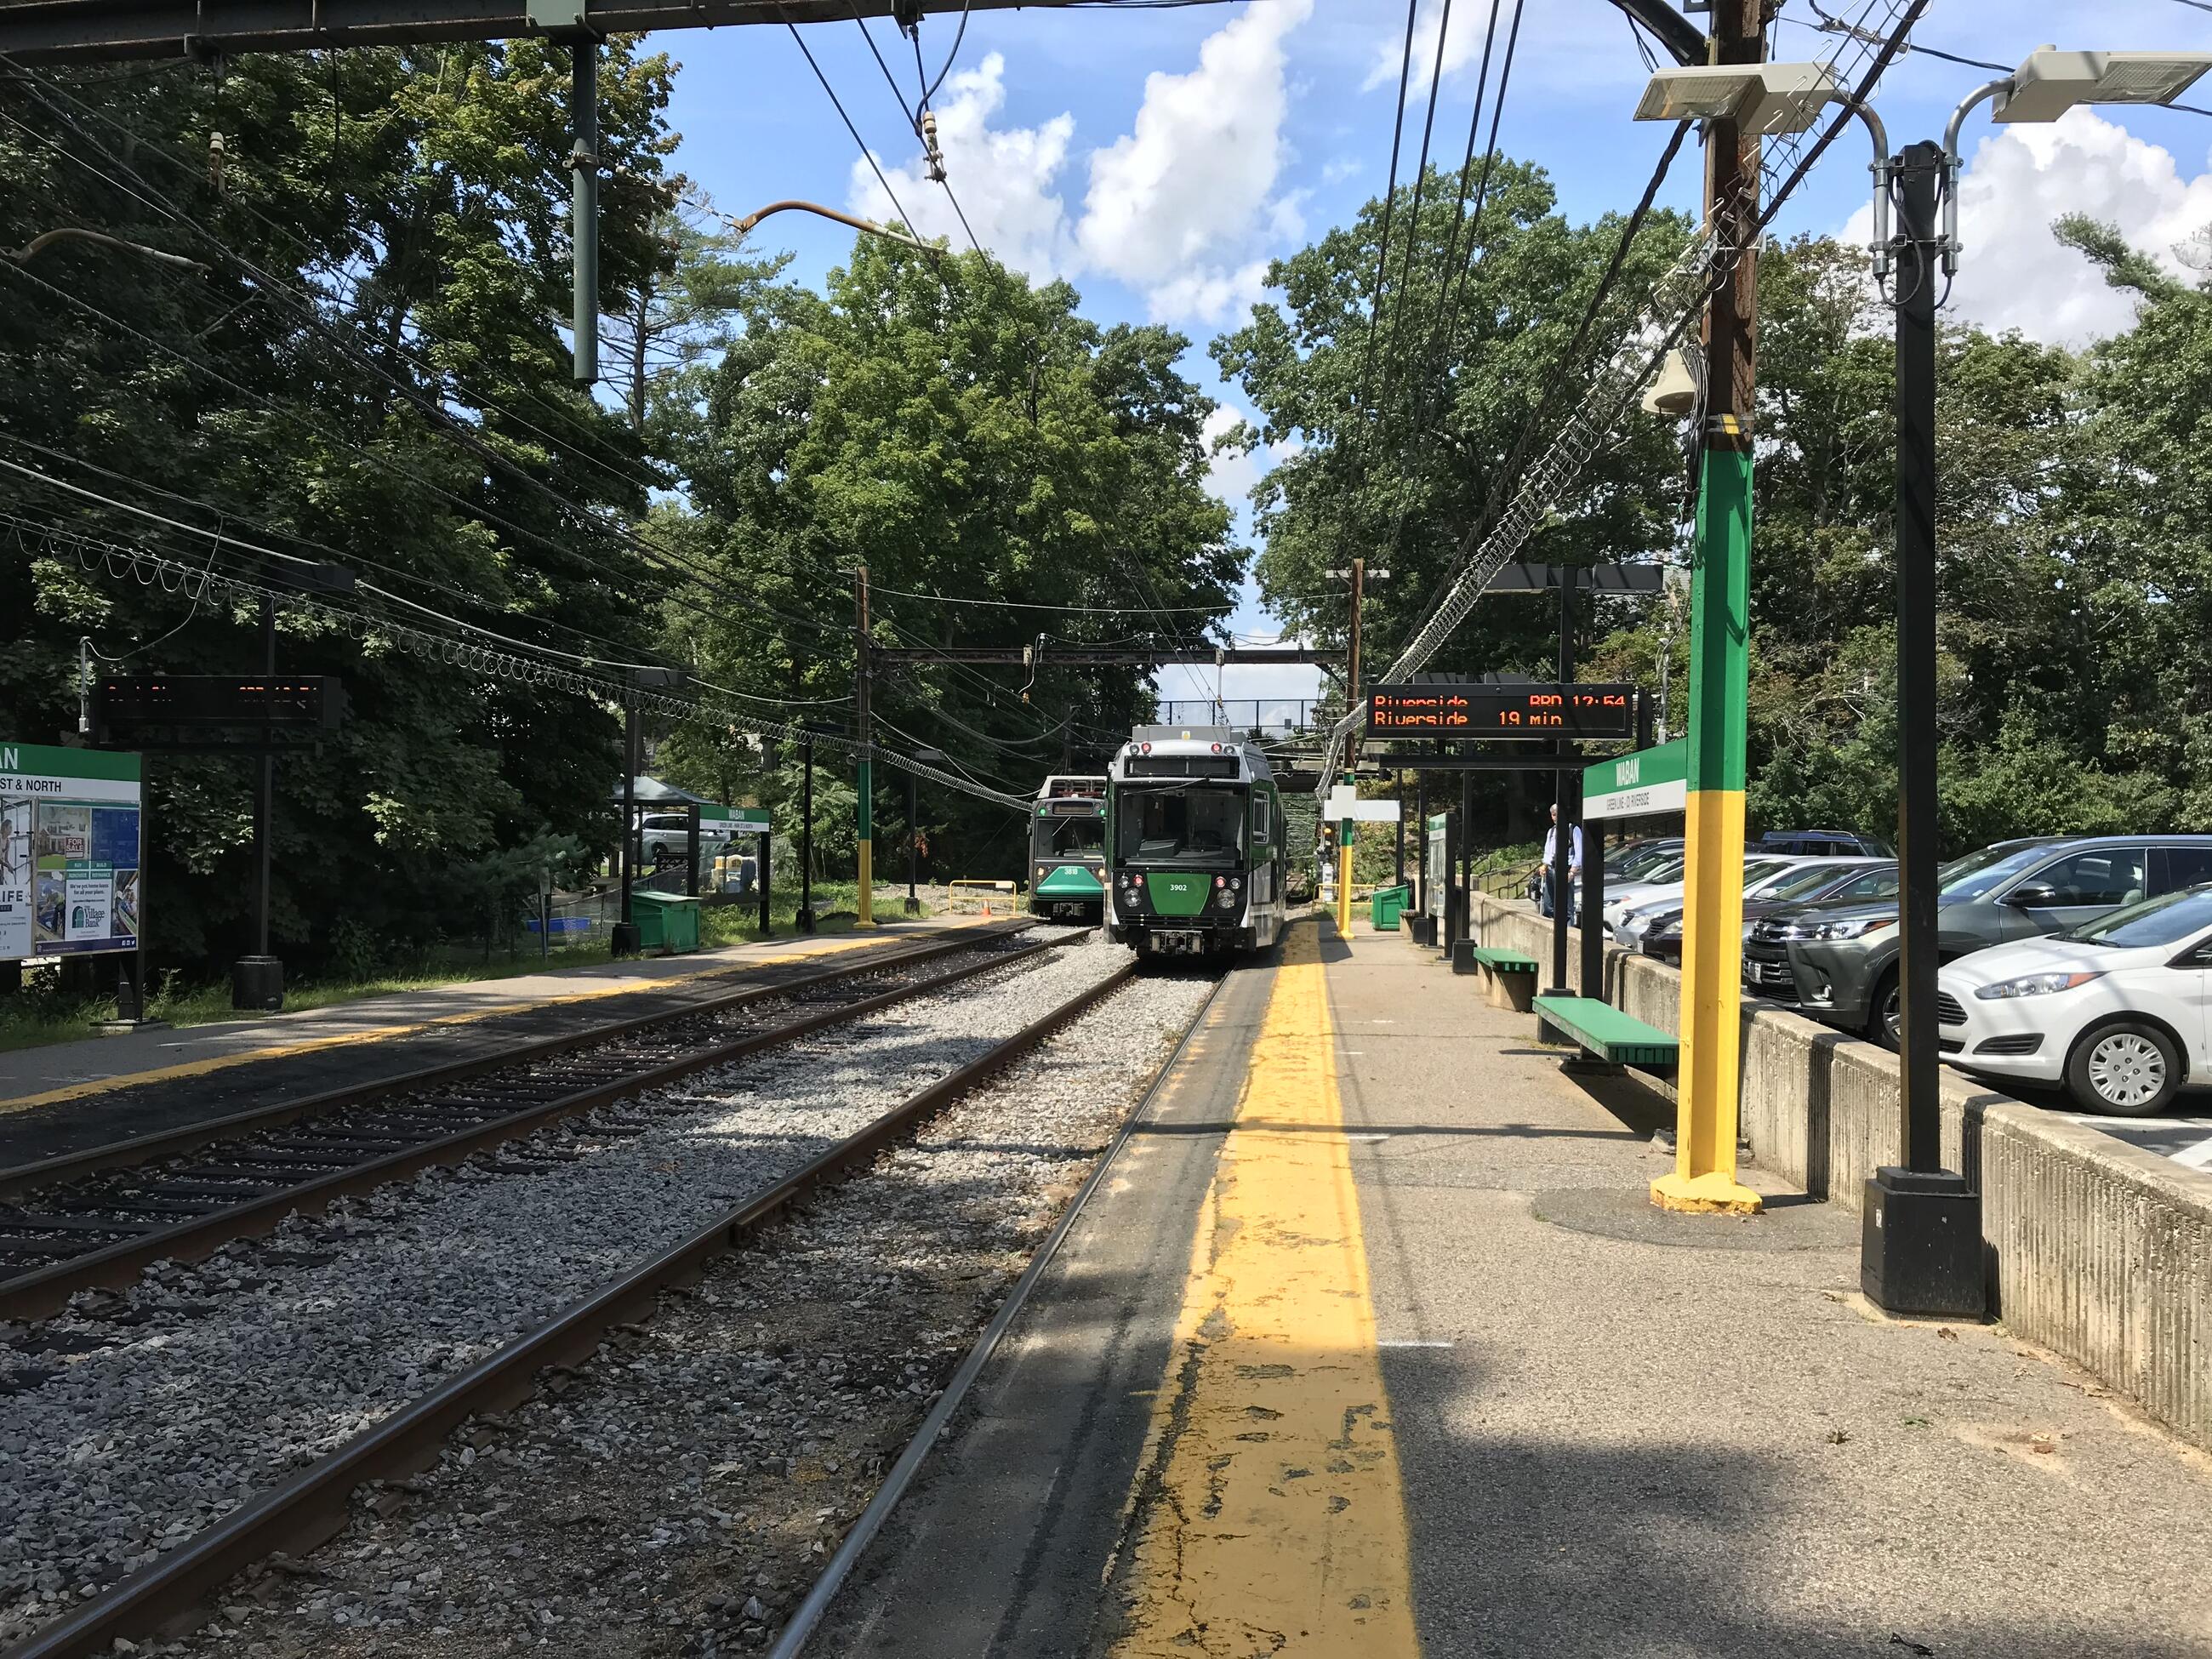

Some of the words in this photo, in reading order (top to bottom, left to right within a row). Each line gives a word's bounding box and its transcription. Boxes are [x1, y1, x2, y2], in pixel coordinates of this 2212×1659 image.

[1374, 711, 1468, 725] Riverside
[1499, 711, 1520, 725] 19
[1530, 711, 1563, 725] min
[1616, 757, 1639, 787] WABAN
[15, 778, 22, 790] &
[26, 779, 61, 792] NORTH
[0, 890, 23, 902] IFE
[84, 908, 105, 921] Village
[85, 918, 100, 927] Bank
